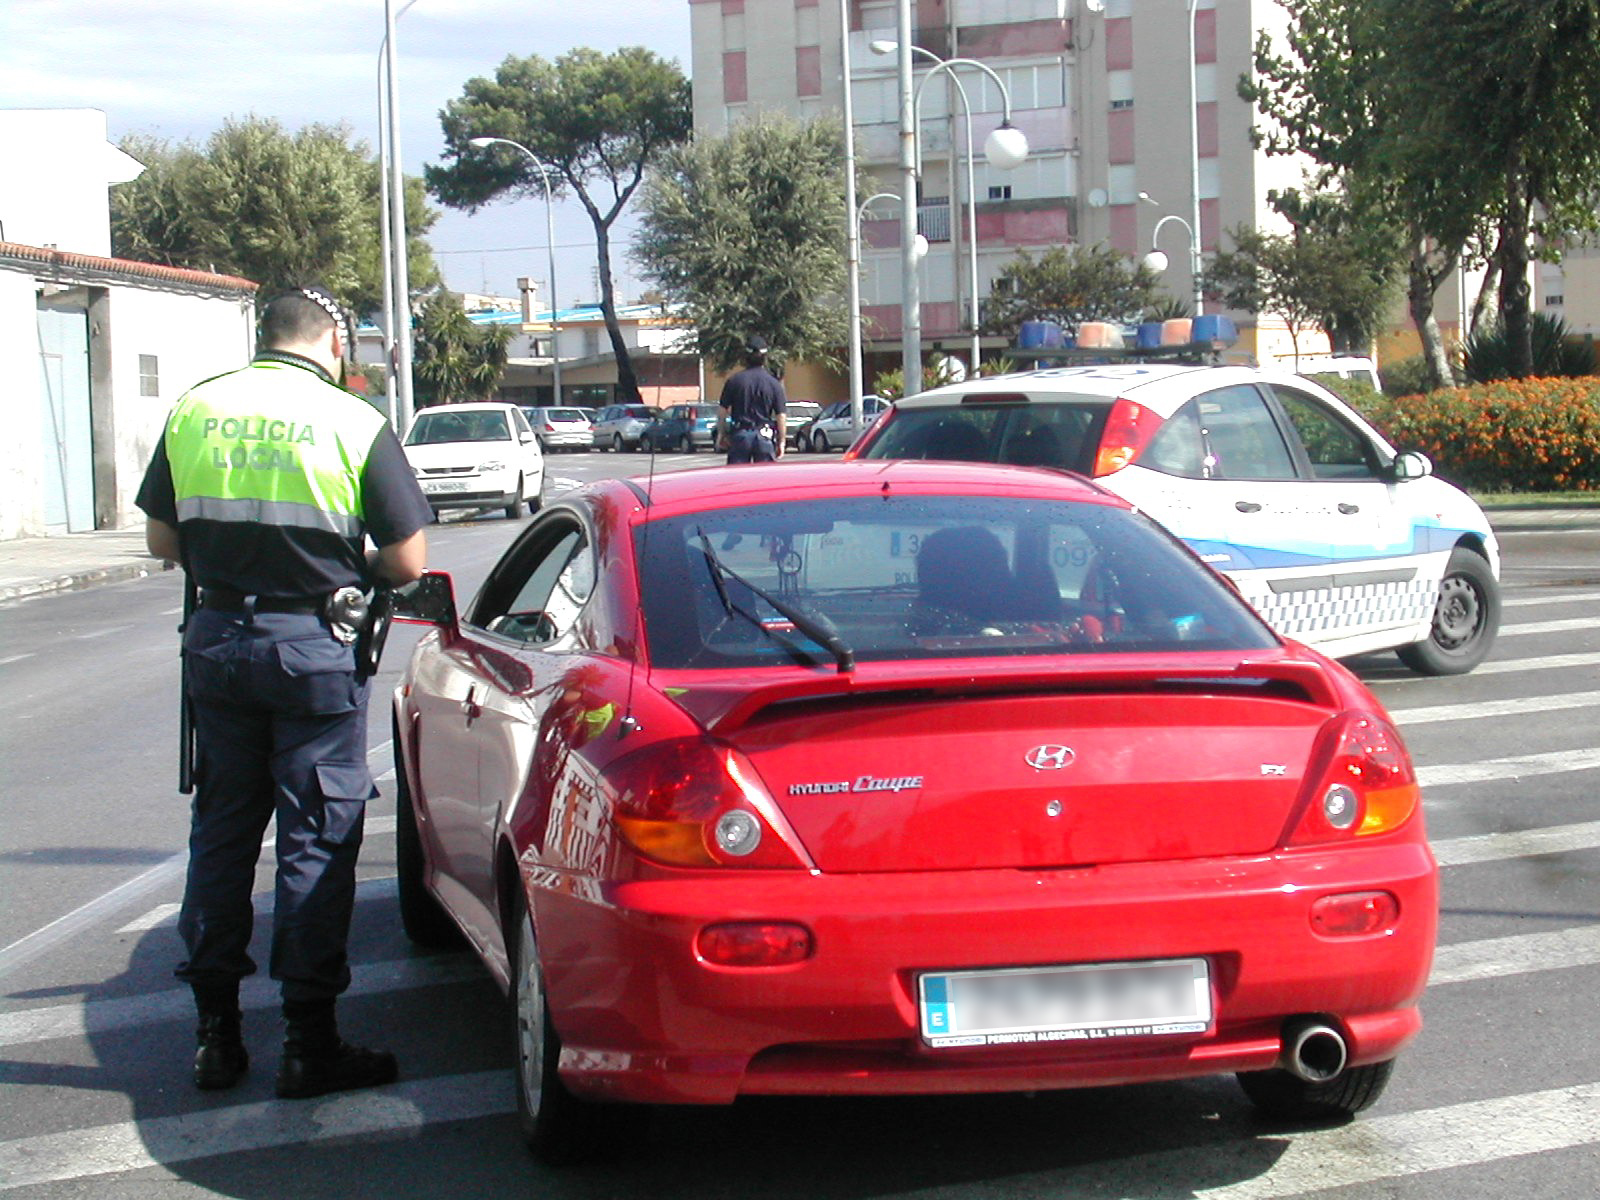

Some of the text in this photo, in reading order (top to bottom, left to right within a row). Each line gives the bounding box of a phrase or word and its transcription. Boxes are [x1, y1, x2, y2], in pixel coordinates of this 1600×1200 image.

[213, 447, 302, 472] LOCAL
[1053, 546, 1089, 568] 09
[894, 572, 919, 584] POLI
[788, 781, 850, 795] HYUNDAI
[931, 1011, 945, 1027] E
